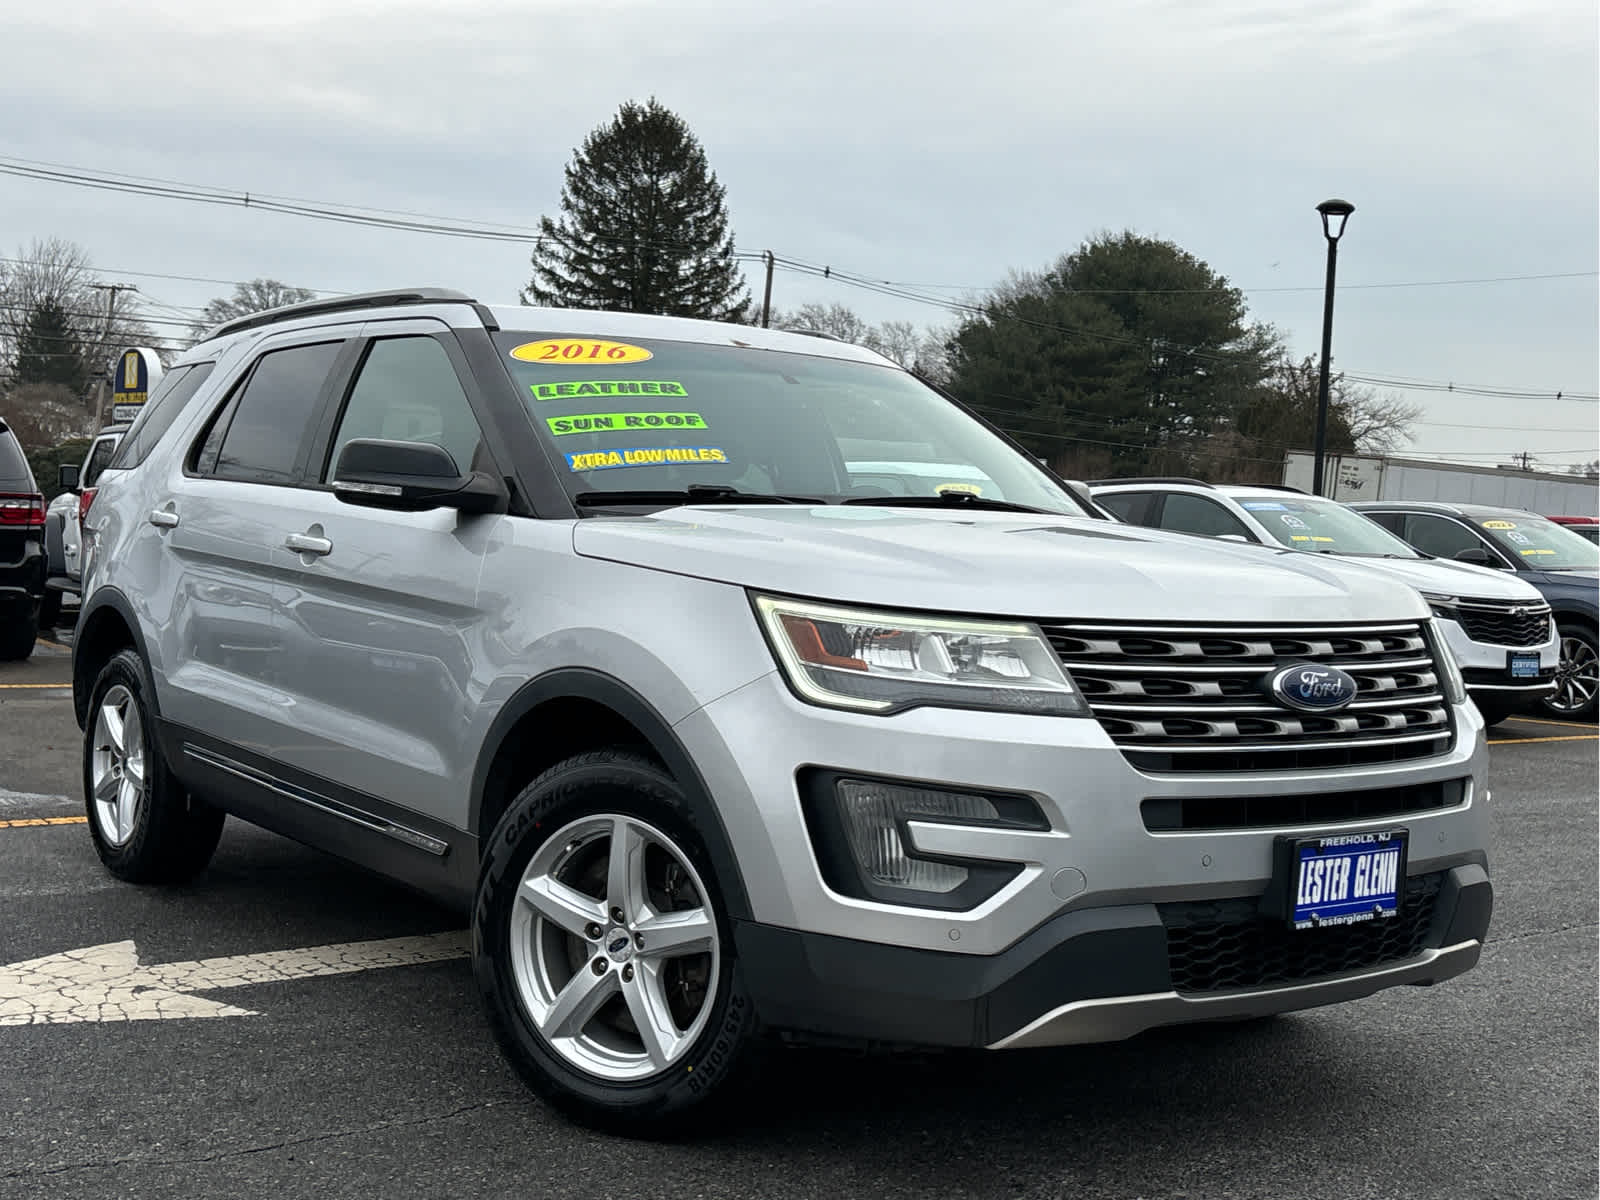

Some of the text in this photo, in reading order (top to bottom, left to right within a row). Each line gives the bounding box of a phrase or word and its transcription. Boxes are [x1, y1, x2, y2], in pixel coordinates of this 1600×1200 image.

[539, 344, 626, 360] 2016
[538, 383, 681, 397] LEATHER
[554, 415, 701, 433] SUN ROOF
[571, 452, 623, 470] XTRA
[1300, 672, 1344, 697] Ford
[1320, 832, 1391, 847] FREEHOLD, NJ
[1297, 851, 1398, 905] LESTER GLENN
[1319, 912, 1374, 927] lesterglenn
